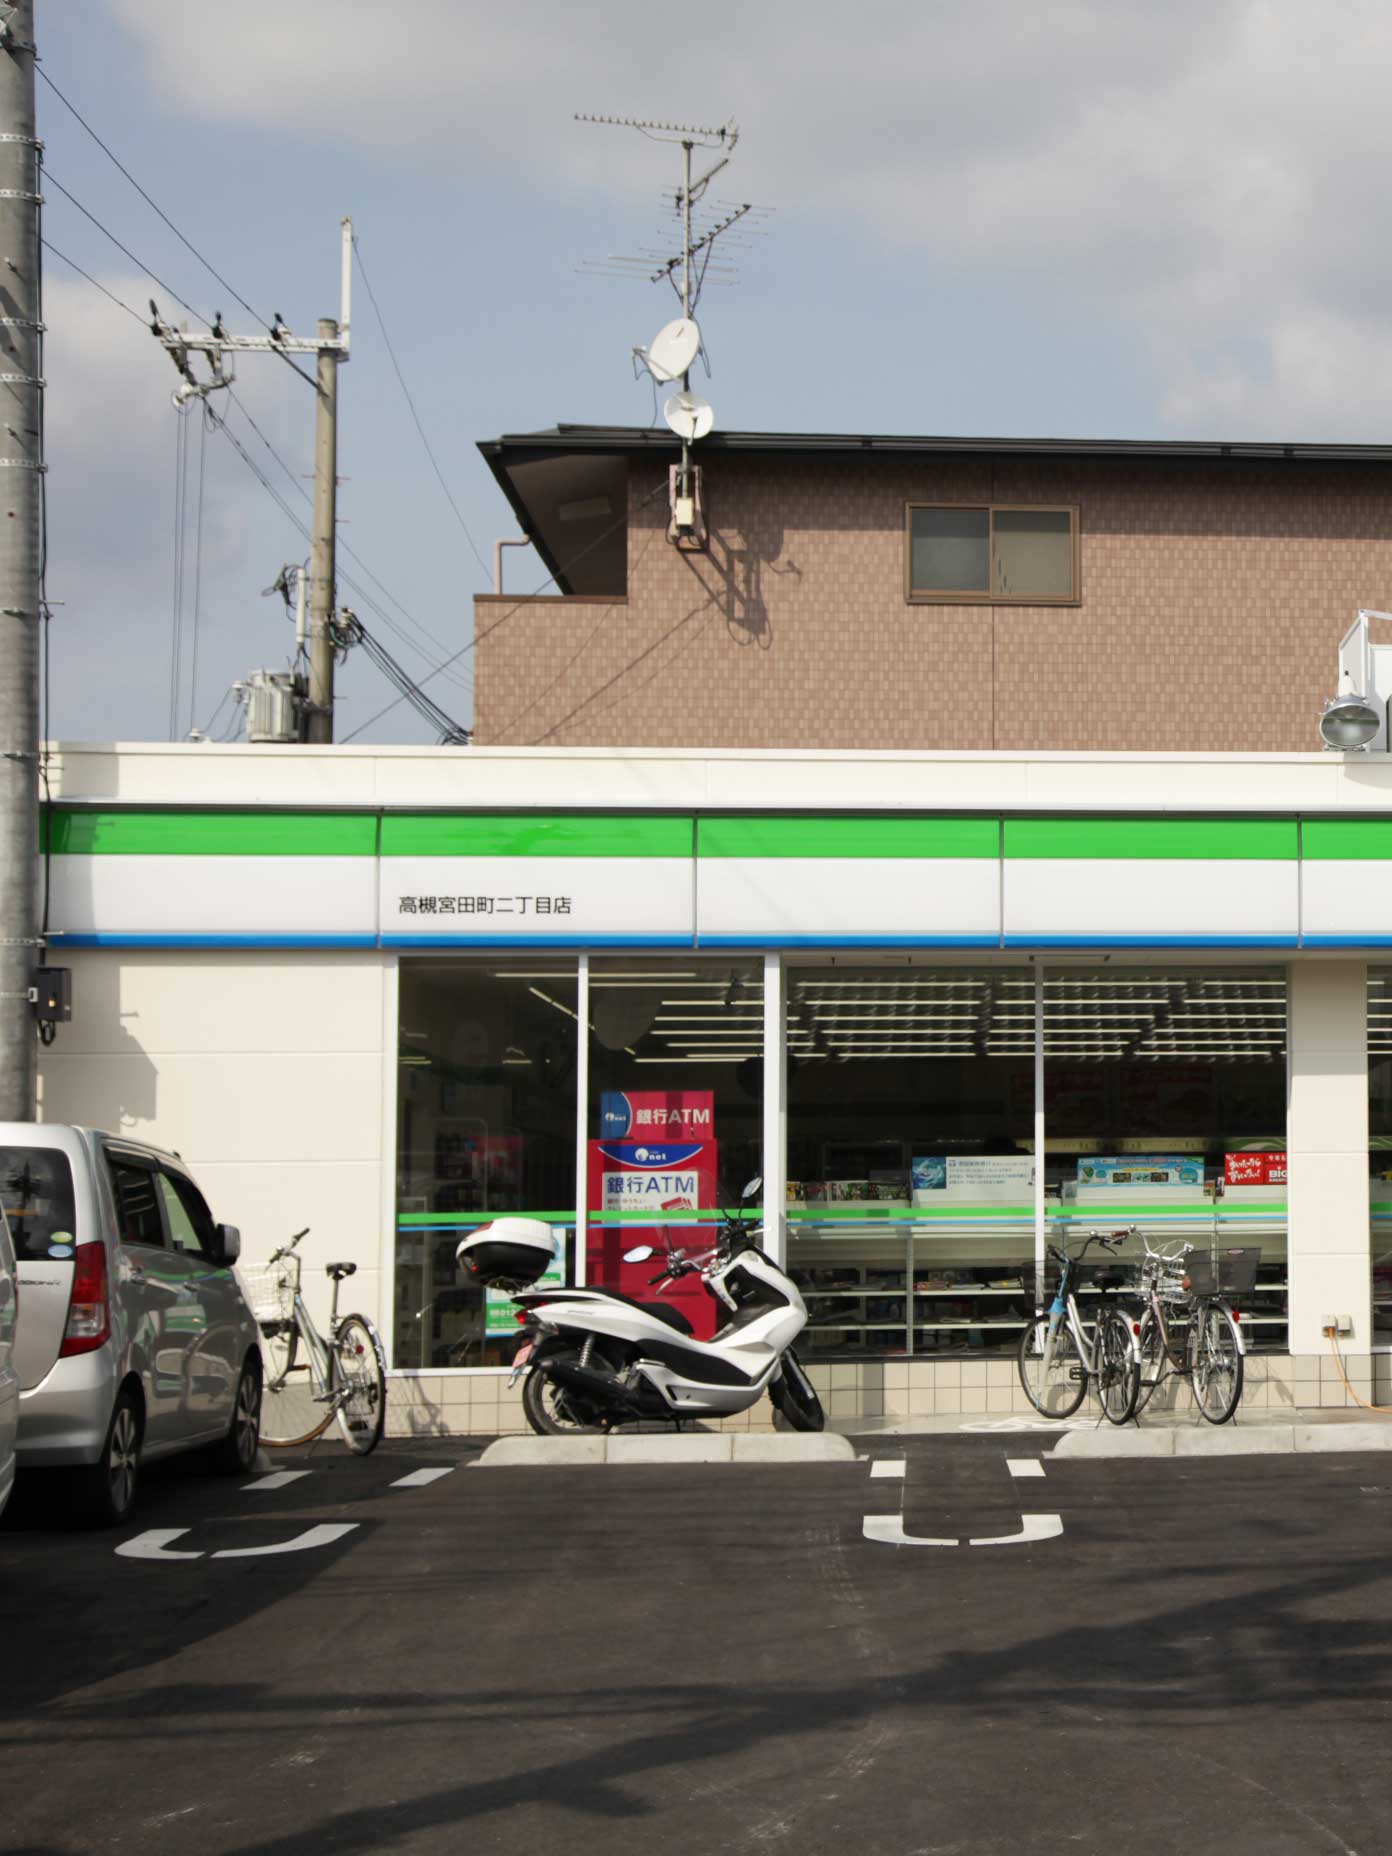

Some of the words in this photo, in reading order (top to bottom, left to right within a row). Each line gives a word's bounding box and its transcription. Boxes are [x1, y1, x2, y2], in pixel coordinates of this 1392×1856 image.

[398, 896, 571, 914] 高槻宮田町二丁目店
[636, 1108, 709, 1124] 銀行ATM
[607, 1176, 694, 1193] 銀行ATM
